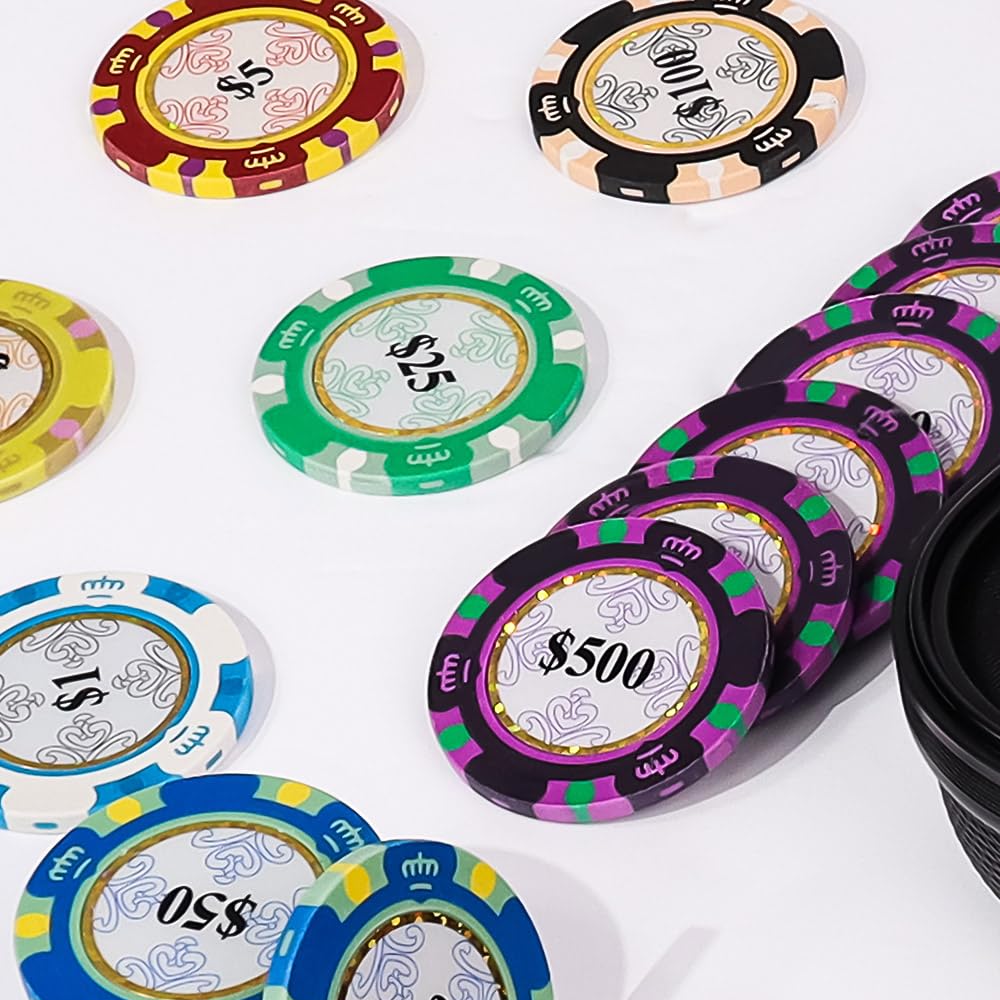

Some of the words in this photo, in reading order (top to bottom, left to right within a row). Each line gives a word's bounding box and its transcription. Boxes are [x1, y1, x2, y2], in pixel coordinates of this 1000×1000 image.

[217, 59, 274, 100] $5
[653, 49, 725, 119] $100
[385, 334, 456, 392] $25
[538, 628, 655, 690] $500
[51, 667, 110, 712] $1
[157, 885, 258, 940] $50
